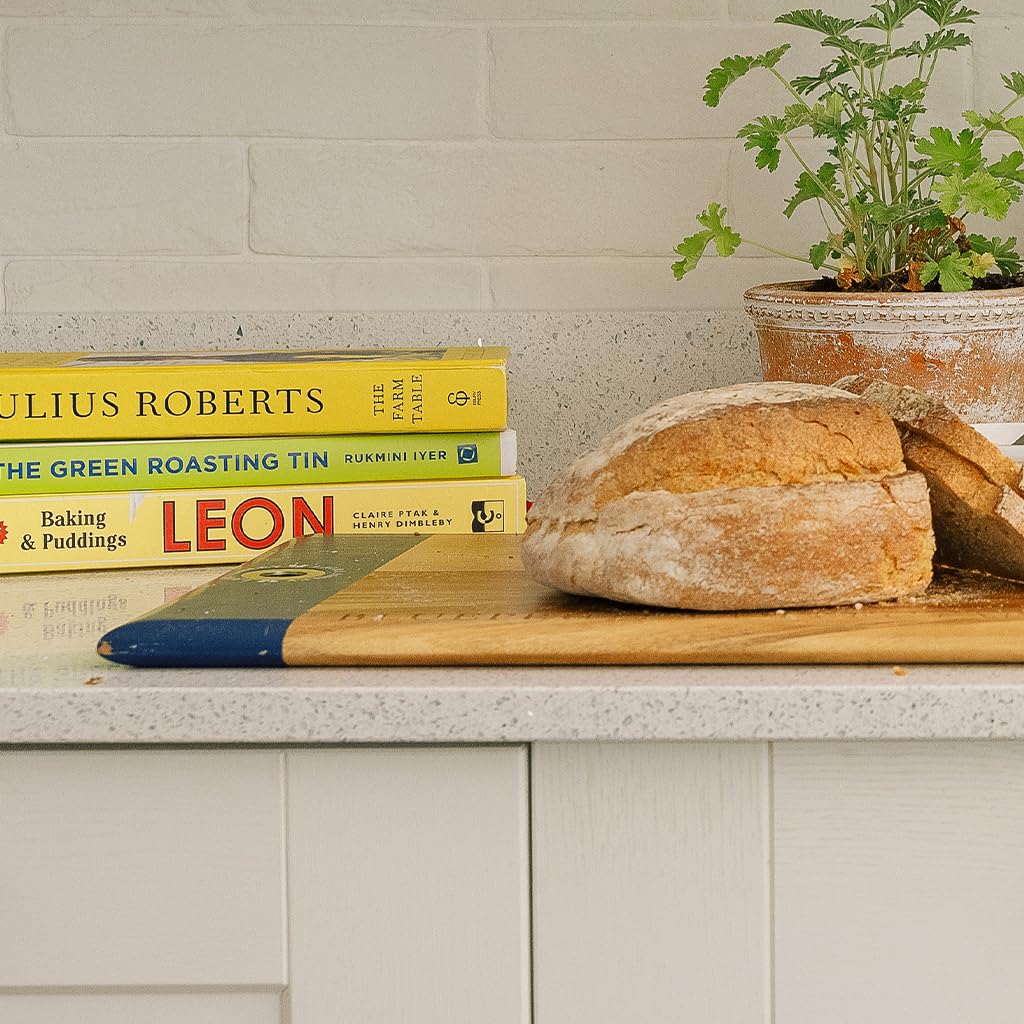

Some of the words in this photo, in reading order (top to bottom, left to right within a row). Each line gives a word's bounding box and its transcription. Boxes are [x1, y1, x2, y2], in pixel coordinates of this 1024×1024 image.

[135, 388, 324, 417] ROBERTS
[373, 383, 385, 416] THE
[392, 378, 404, 421] FARM
[411, 374, 423, 424] TABLE
[50, 458, 138, 479] GREEN
[148, 453, 279, 475] ROASTING
[287, 451, 329, 470] TIN
[344, 451, 407, 464] RUKMINI
[413, 450, 448, 461] IYER
[41, 510, 107, 530] Baking
[162, 495, 334, 553] LEON
[352, 511, 394, 519] CLAIRE
[398, 509, 428, 517] PTAK
[432, 509, 440, 517] &
[352, 521, 391, 529] HENRY
[396, 518, 453, 528] DIMBLEBY
[20, 534, 37, 551] &
[42, 532, 127, 552] Puddings
